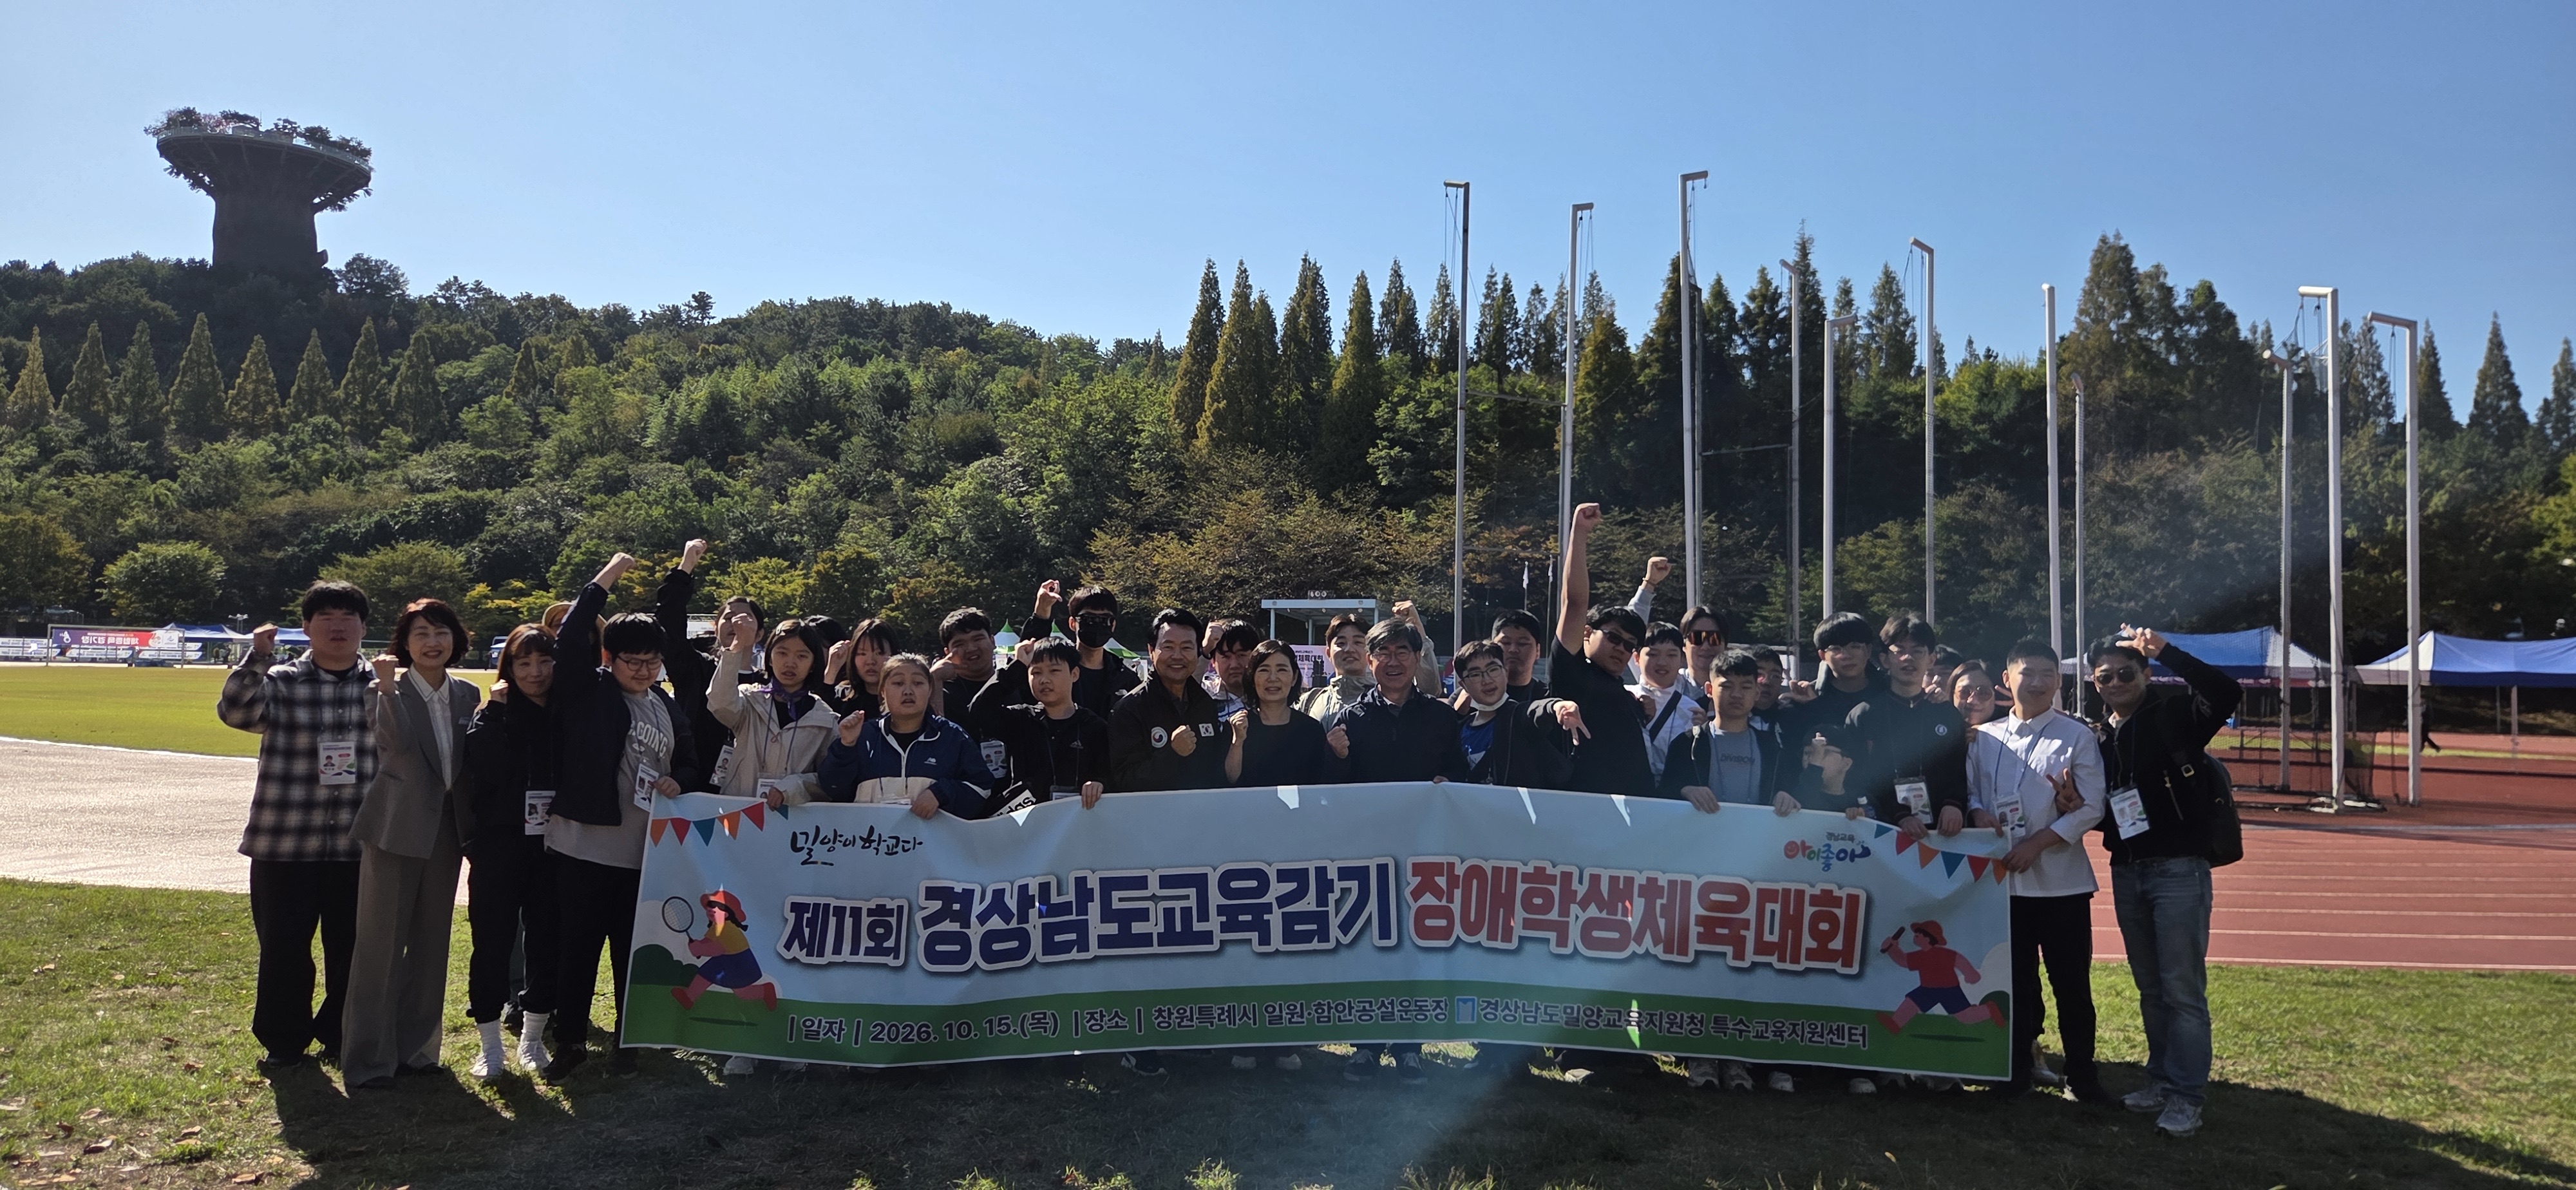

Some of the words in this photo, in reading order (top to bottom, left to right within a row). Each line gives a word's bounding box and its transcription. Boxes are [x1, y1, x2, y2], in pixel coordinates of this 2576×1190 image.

[1783, 839, 1871, 873] 아이좋아
[782, 901, 904, 960] 제11회
[922, 864, 1393, 967] 경상남도교육감기
[1408, 860, 1862, 970] 장애학생체육대회
[870, 1021, 938, 1043] 2026.
[944, 1020, 979, 1041] 10.
[1152, 1002, 1258, 1030] 창원특례시
[1480, 997, 1705, 1038] 경상남도밀양교육지원청
[1709, 1014, 1868, 1050] 특수교육지원센터
